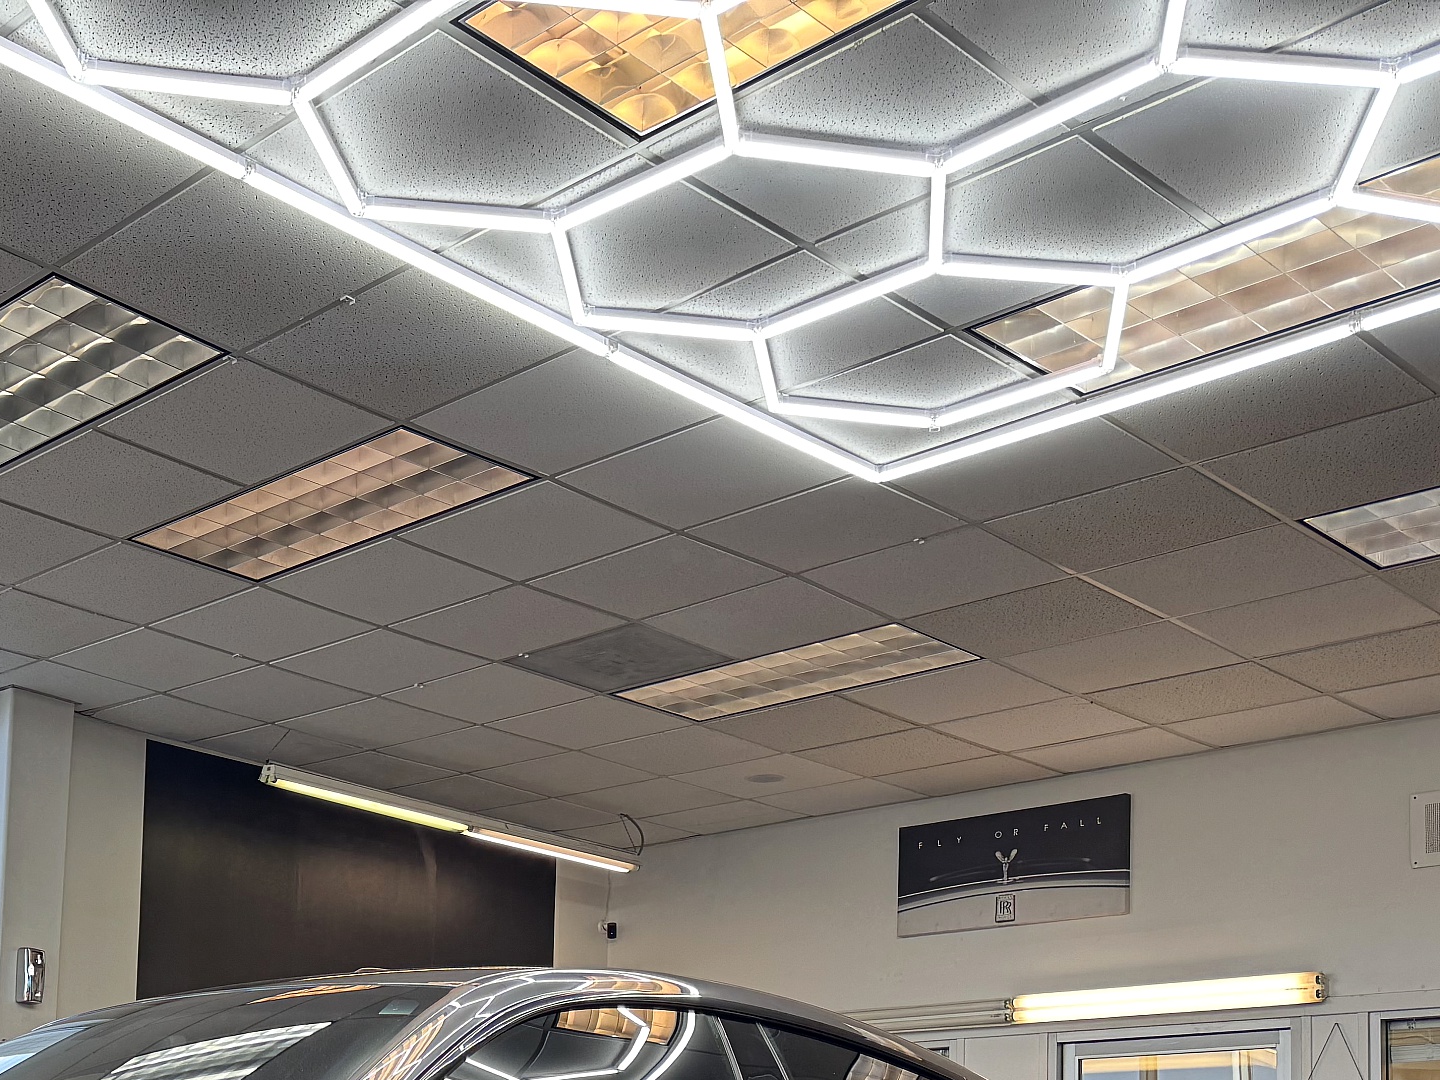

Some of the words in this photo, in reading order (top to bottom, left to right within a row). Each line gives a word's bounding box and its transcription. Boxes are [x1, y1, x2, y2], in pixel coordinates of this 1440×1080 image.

[918, 836, 962, 850] FLY
[994, 828, 1019, 840] OR
[1043, 816, 1102, 832] FALL
